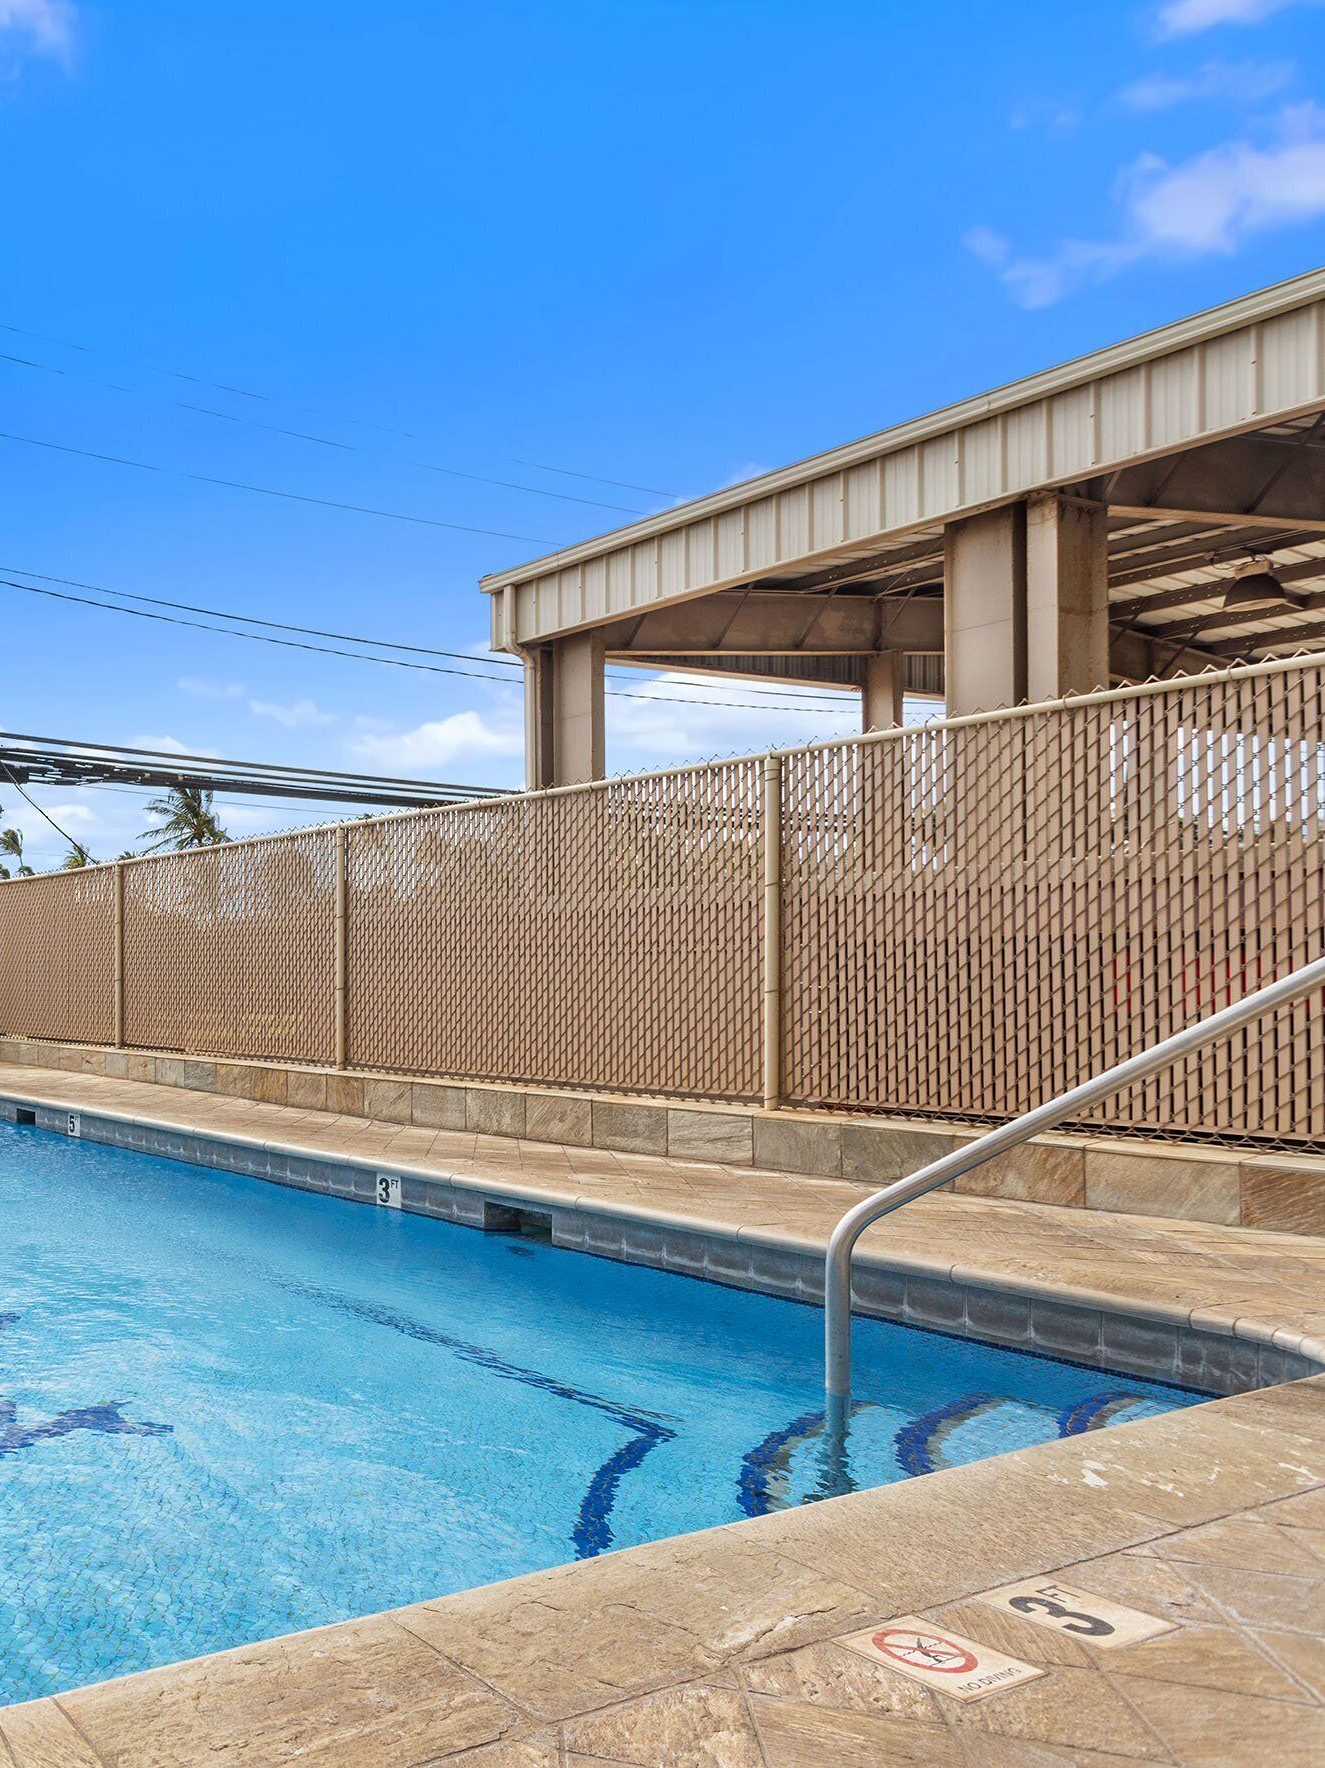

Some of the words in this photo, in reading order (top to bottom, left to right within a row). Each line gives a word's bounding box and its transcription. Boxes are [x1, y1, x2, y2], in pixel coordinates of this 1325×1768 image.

[69, 1115, 75, 1133] 5
[379, 1178, 390, 1203] 3
[391, 1179, 399, 1189] FT
[1035, 1585, 1081, 1603] FT
[1009, 1596, 1116, 1636] 3
[957, 1682, 982, 1693] NO
[978, 1667, 1022, 1686] DIVING
